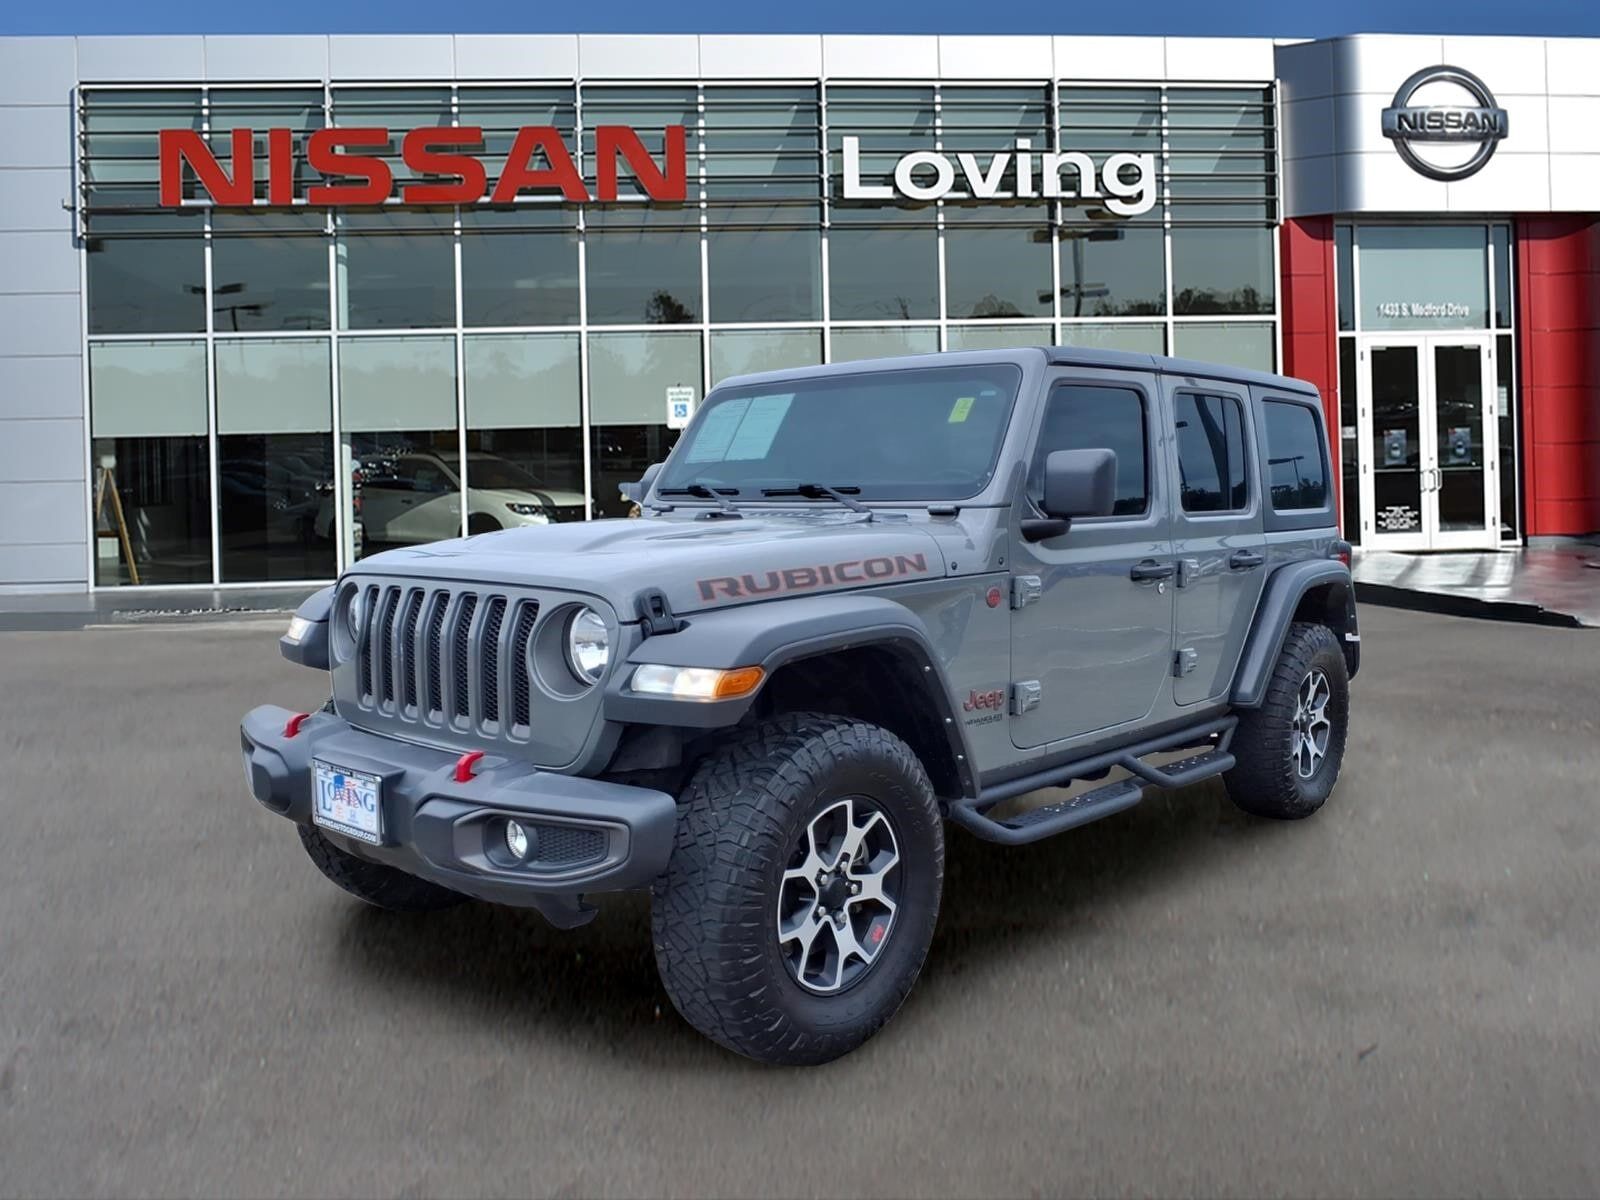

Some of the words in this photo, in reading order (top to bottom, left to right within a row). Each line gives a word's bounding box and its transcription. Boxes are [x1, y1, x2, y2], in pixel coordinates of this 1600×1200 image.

[1396, 111, 1499, 132] NISSAN
[159, 125, 688, 207] NISSAN
[842, 136, 1157, 217] Loving
[1447, 303, 1470, 317] Drive
[697, 553, 928, 602] RUBICON
[963, 688, 1004, 712] Jeep
